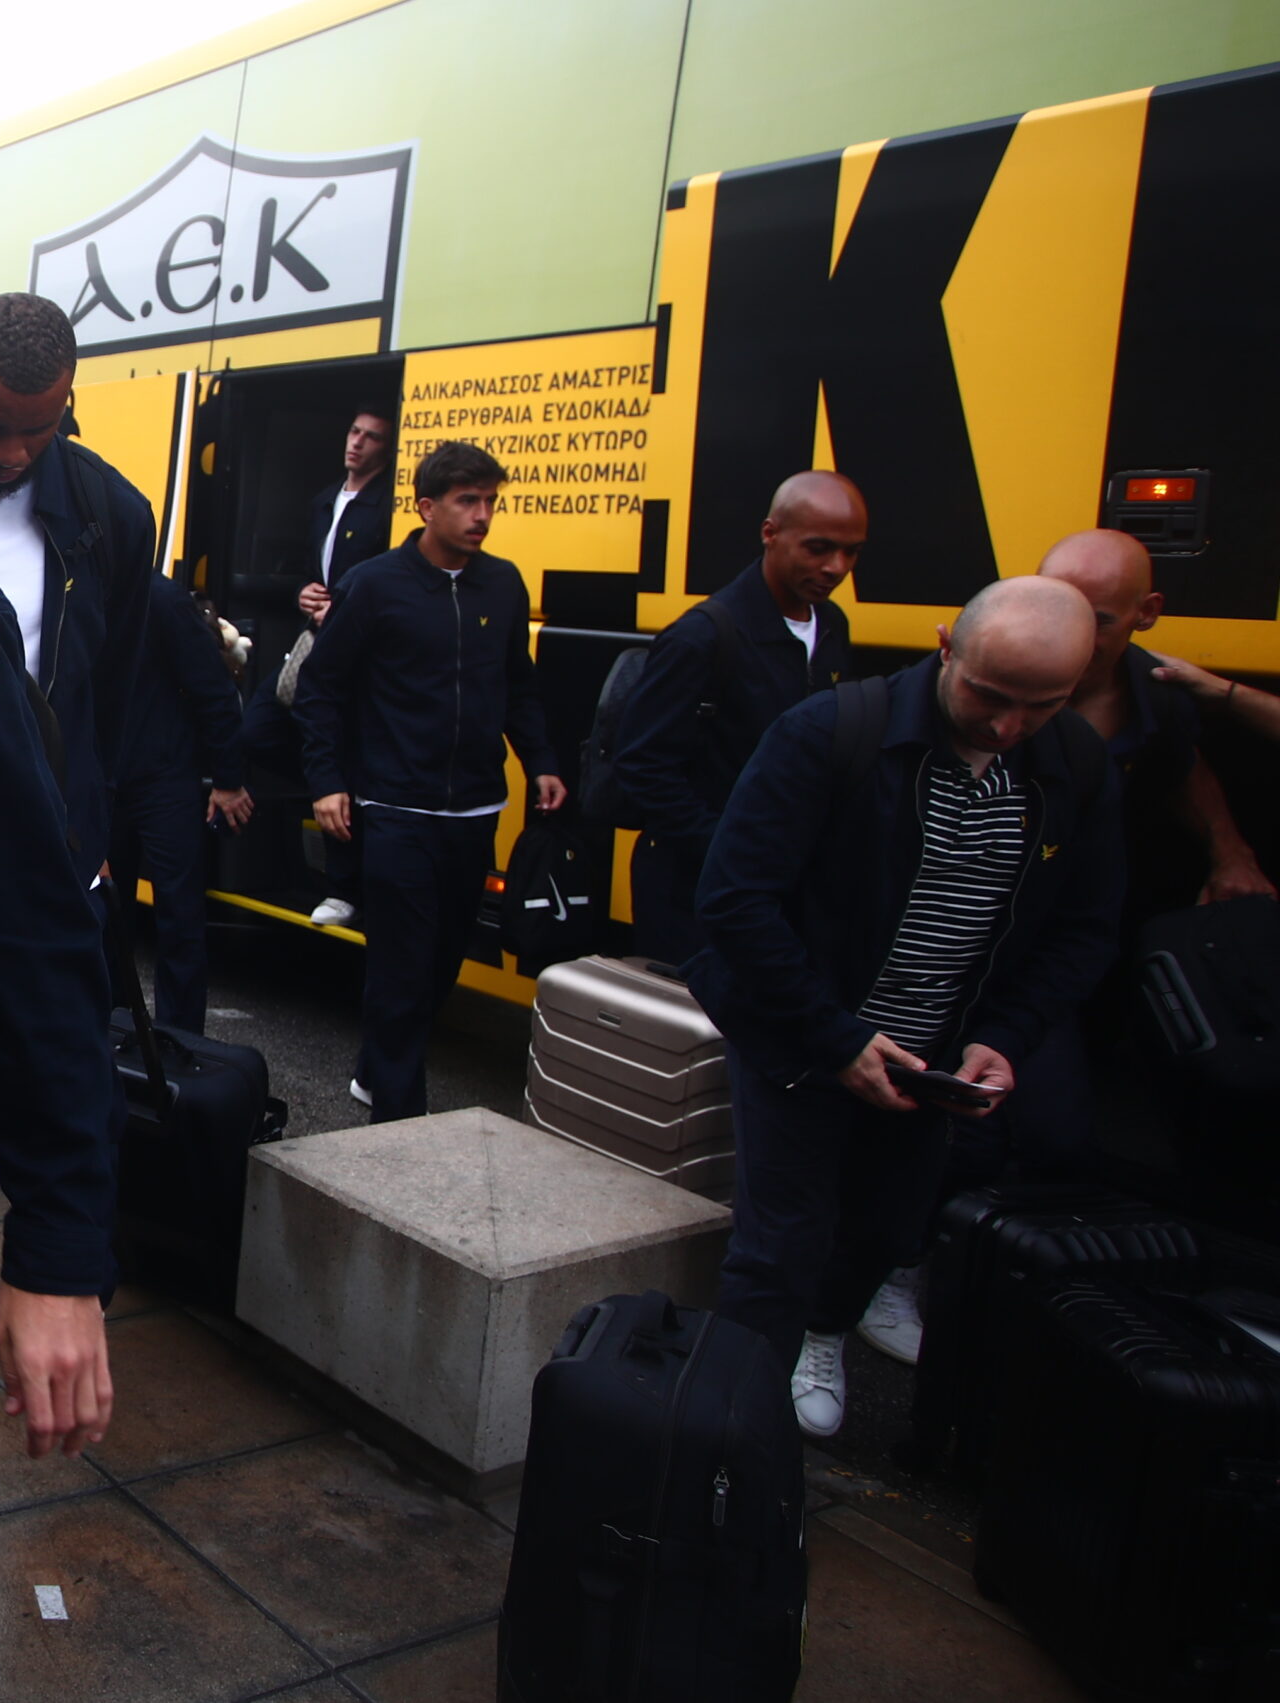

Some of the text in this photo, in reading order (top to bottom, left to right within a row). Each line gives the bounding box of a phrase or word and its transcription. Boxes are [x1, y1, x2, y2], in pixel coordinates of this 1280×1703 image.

[410, 363, 651, 401] ΑΛΙΚΑΡΝΑΣΣΟΣ ΑΜΑΣΤΡΙΣ
[447, 405, 532, 427] ΕΡΥΘΡΑΙΑ
[484, 433, 561, 454] ΚΥΖΙΚΟΣ
[567, 429, 647, 452] ΚΥΤΩΡΟ
[545, 461, 646, 483] ΝΙΚΟΜΗΔΙ
[512, 494, 600, 514] ΤΕΝΕΔΟΣ
